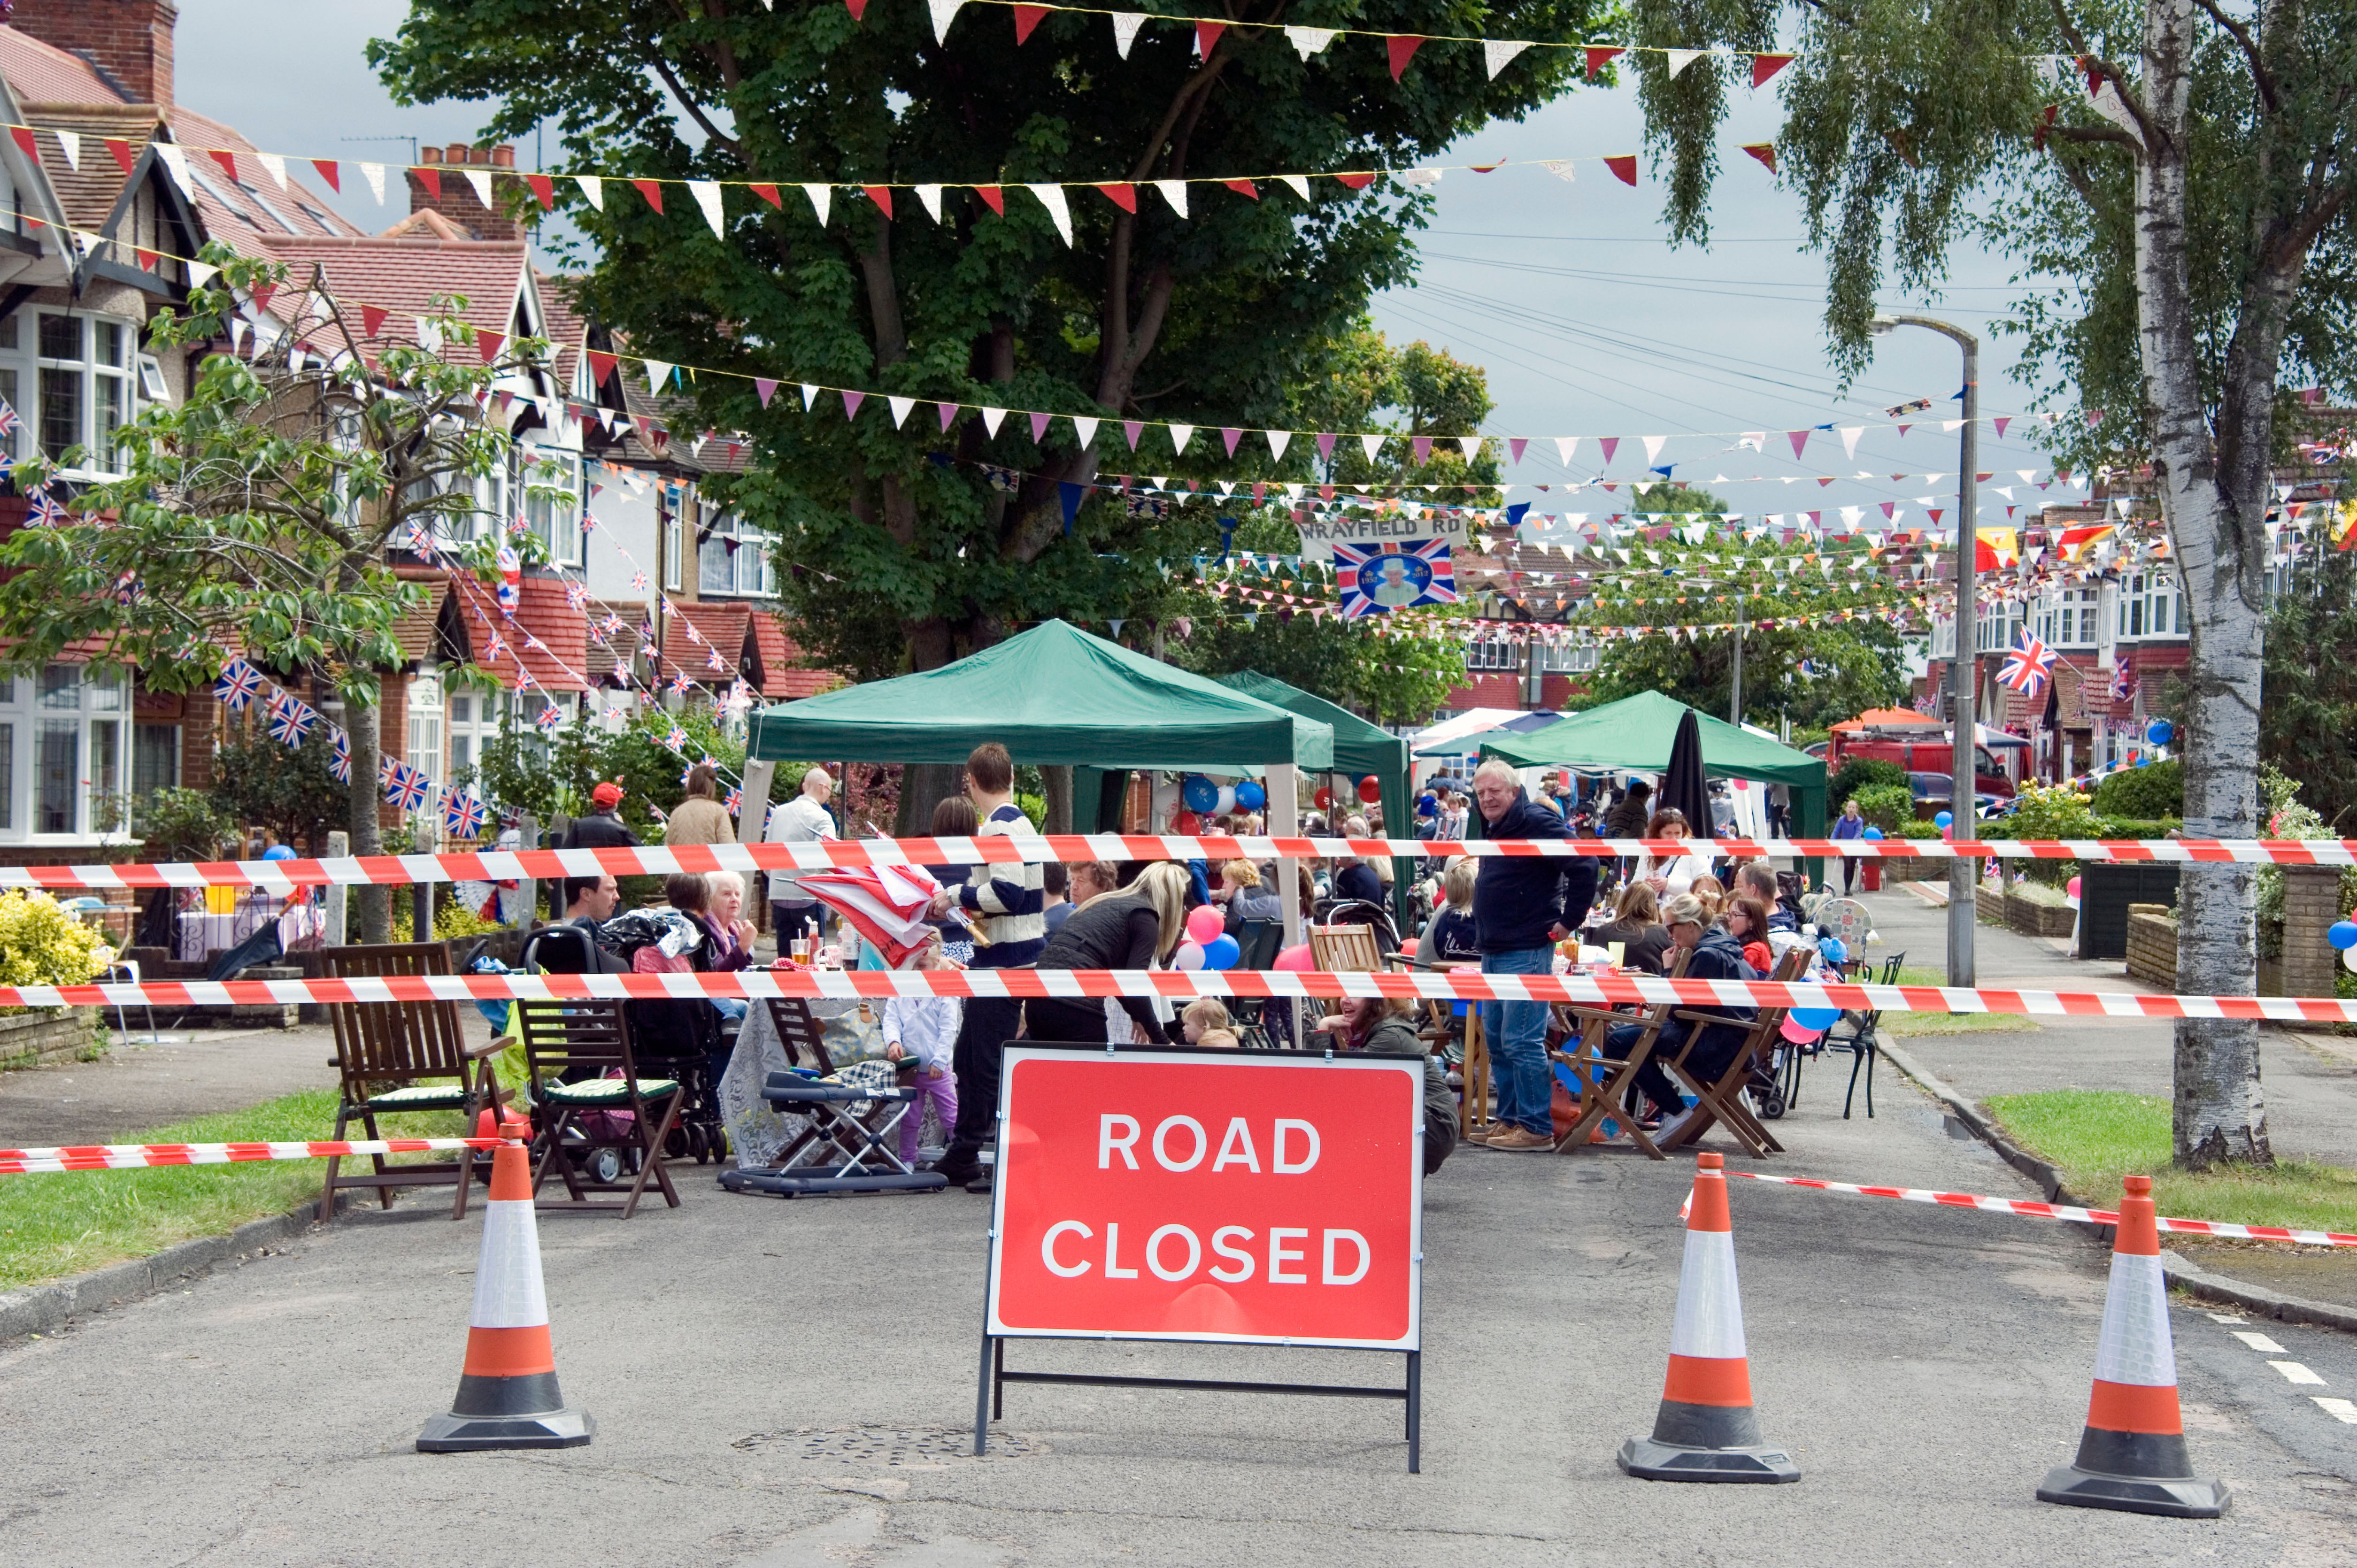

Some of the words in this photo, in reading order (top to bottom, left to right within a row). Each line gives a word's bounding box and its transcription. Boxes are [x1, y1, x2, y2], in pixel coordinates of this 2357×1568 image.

[1299, 520, 1417, 539] WRAYFIELD
[1433, 518, 1460, 534] RD
[1098, 1113, 1321, 1174] ROAD
[1041, 1220, 1371, 1285] CLOSED
